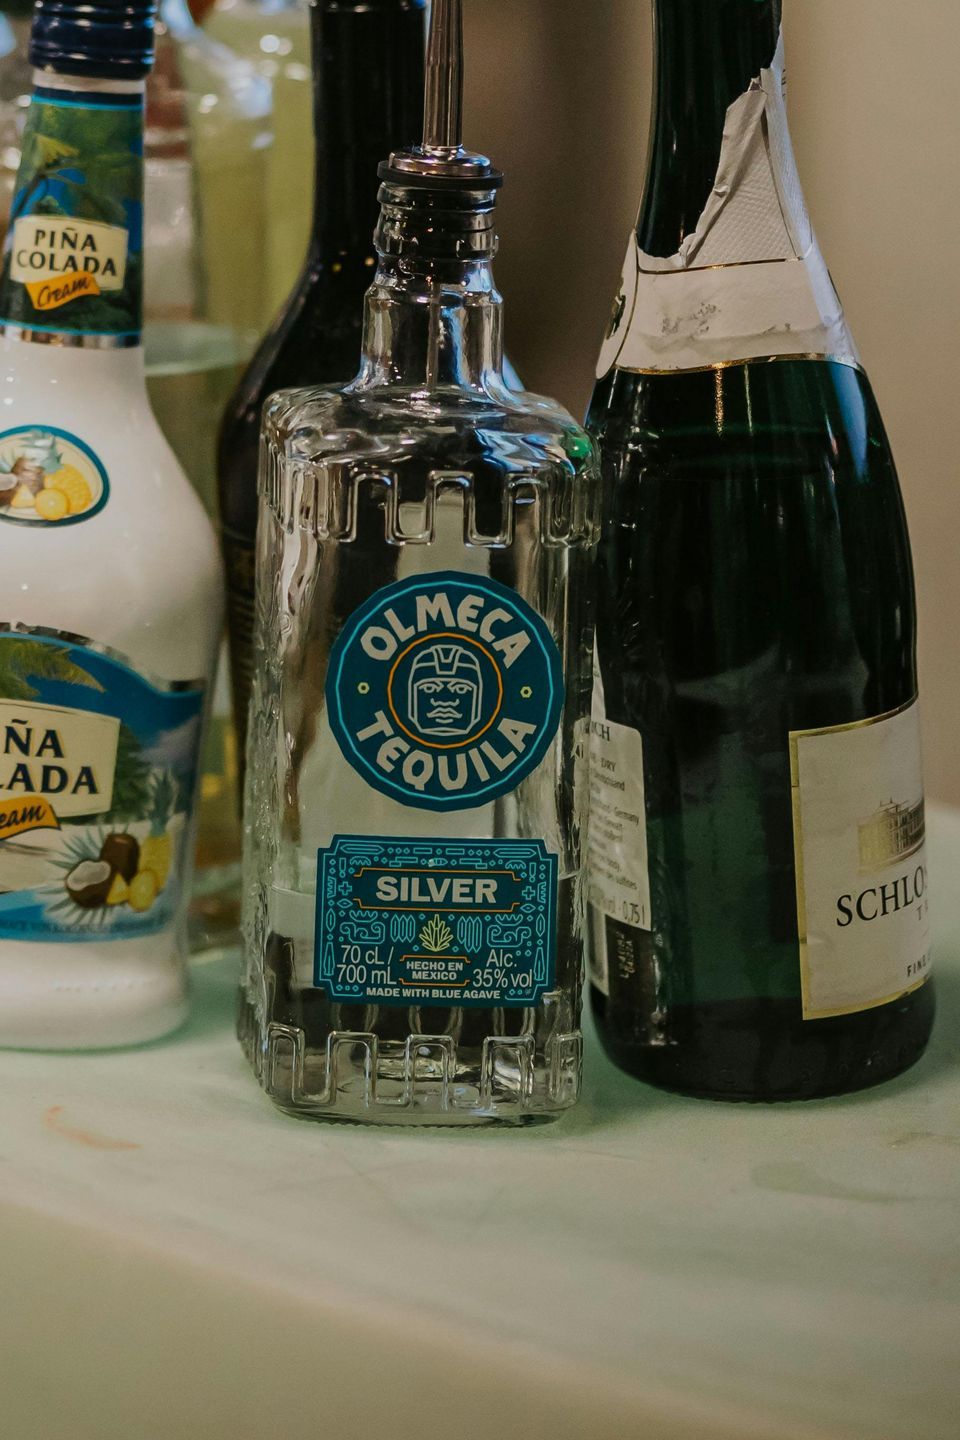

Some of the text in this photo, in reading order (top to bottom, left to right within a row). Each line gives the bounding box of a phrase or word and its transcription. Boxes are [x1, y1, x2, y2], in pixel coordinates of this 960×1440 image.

[34, 227, 97, 252] PIÑA
[17, 249, 117, 277] COLADA
[37, 276, 89, 308] Cream
[360, 592, 531, 669] OLMECA
[356, 710, 538, 791] TEQUILA
[376, 876, 498, 904] SILVER
[341, 945, 361, 964] 70
[365, 946, 385, 965] cL
[486, 949, 517, 968] Alc.
[336, 964, 397, 985] 700 mL
[406, 961, 463, 971] HECHO EN
[412, 971, 457, 981] MEXICO
[472, 969, 532, 988] 35% vol
[366, 988, 501, 999] MADE WITH BLUE AGAVE
